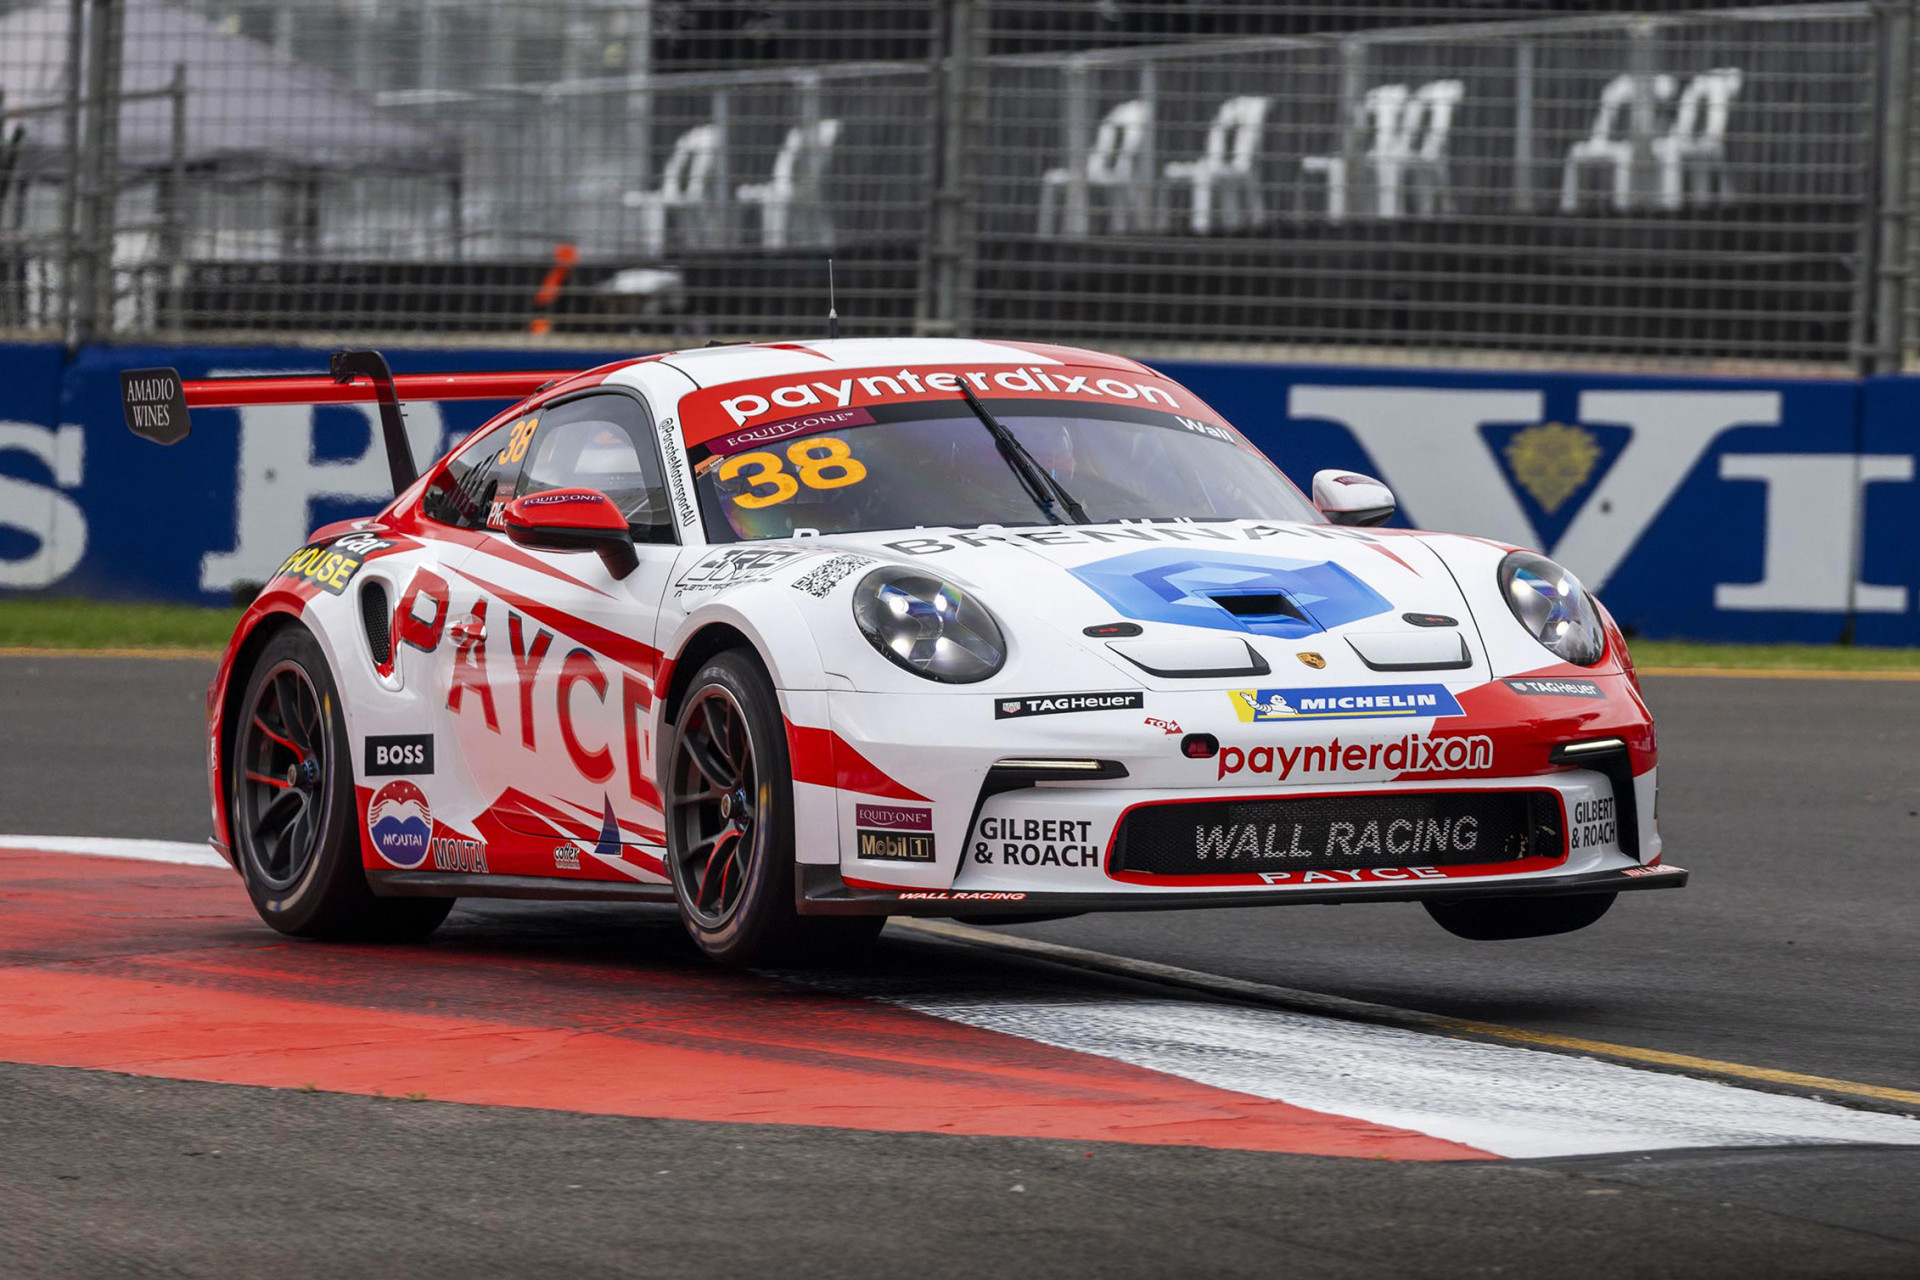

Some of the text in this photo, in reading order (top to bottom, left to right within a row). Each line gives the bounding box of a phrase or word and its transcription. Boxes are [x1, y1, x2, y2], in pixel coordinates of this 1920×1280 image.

[127, 378, 174, 402] AMADIO
[719, 366, 1180, 427] paynterdixon
[133, 404, 170, 428] WINES
[1174, 415, 1236, 443] Wall
[499, 418, 539, 466] 38
[658, 417, 697, 527] @PorscheMotorsportAU
[718, 437, 867, 509] 38
[334, 533, 391, 555] Car
[1301, 694, 1437, 710] MICHELIN
[1148, 718, 1179, 732] TOW
[377, 744, 424, 765] BOSS
[1218, 733, 1492, 782] paynterdixon
[1575, 797, 1613, 824] GILBERT
[383, 833, 422, 847] MOUTAI
[980, 817, 1092, 842] GILBERT
[1196, 815, 1479, 860] WALL RACING
[1571, 821, 1615, 849] & ROACH
[432, 838, 489, 873] MOUTAI
[862, 834, 907, 857] Mobil
[974, 841, 1099, 867] & ROACH
[1257, 866, 1448, 885] PAYCE
[898, 892, 1027, 901] WALL RACING
